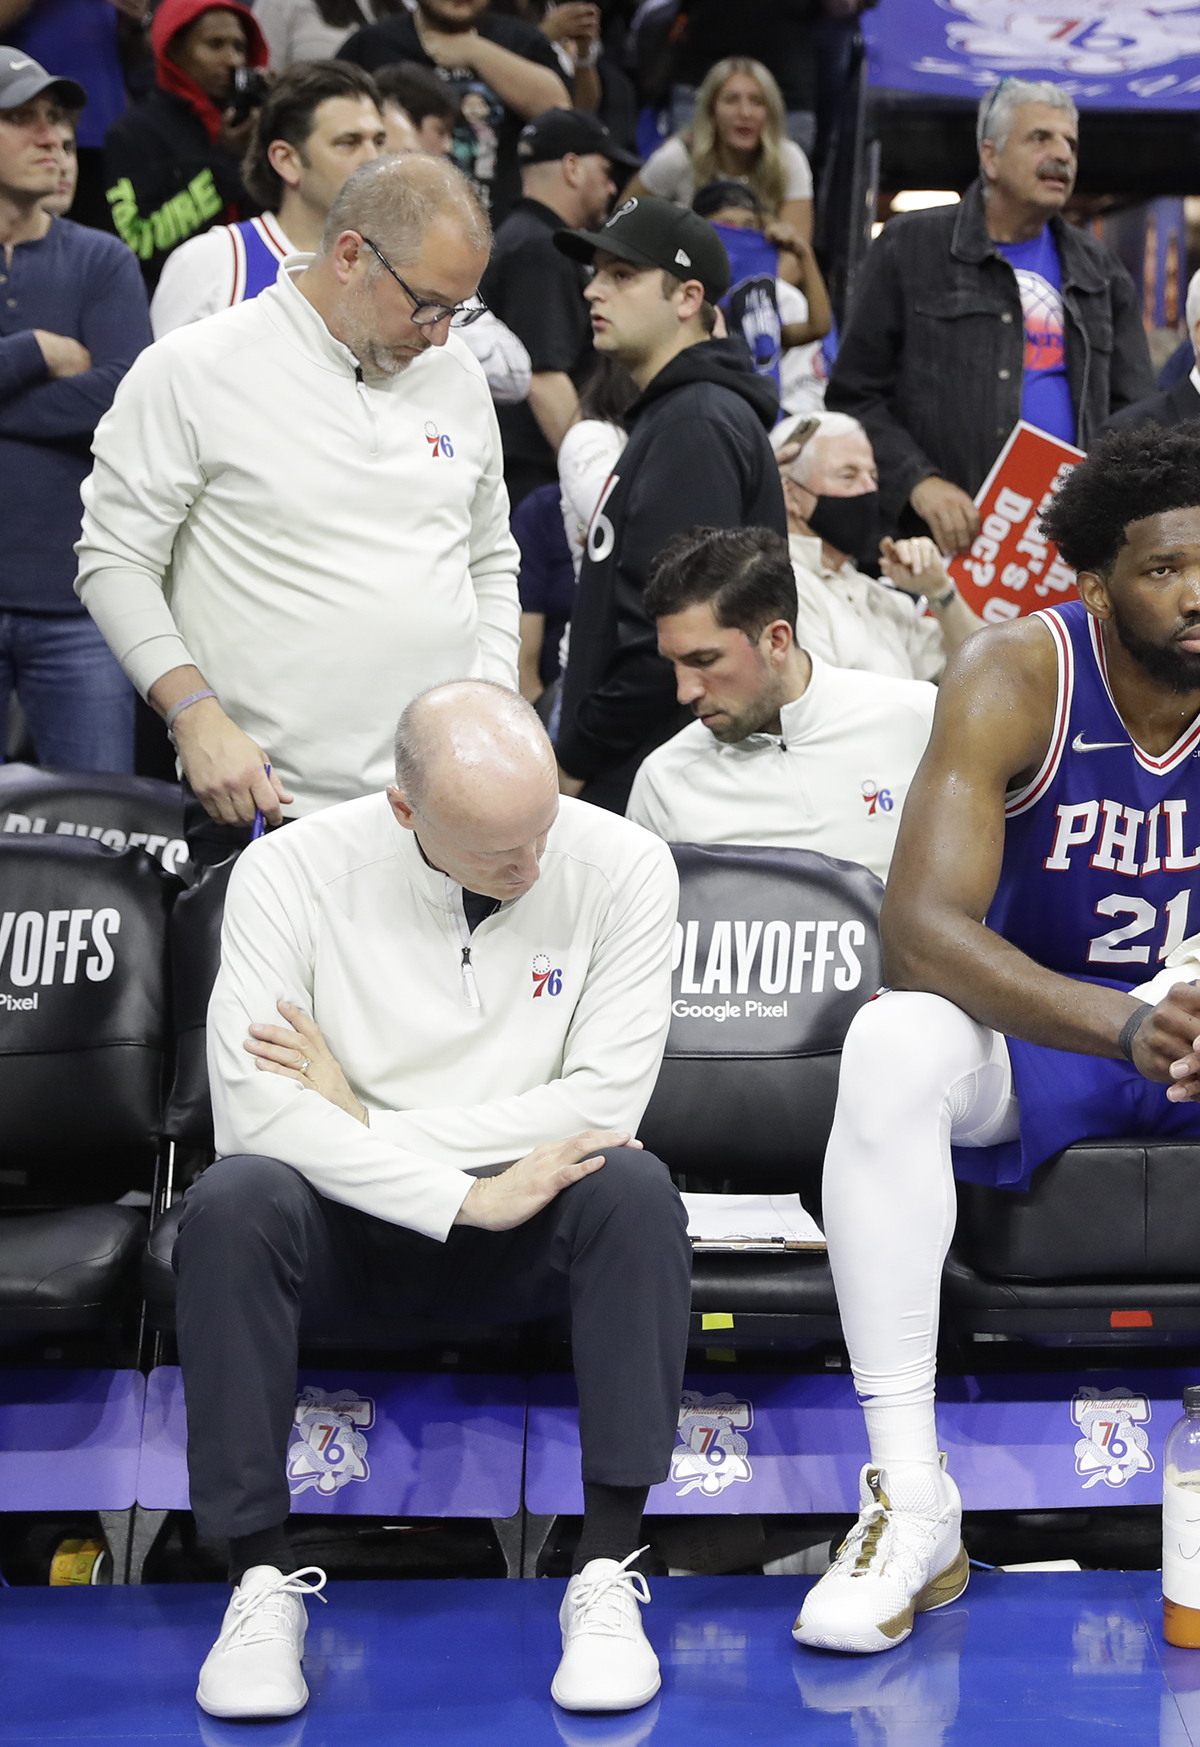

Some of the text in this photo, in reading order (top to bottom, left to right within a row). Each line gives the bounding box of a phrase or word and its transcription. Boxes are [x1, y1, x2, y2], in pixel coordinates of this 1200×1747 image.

[425, 434, 455, 458] 76
[962, 486, 1034, 588] Doc?
[861, 789, 894, 816] 76
[1086, 889, 1192, 965] 21
[532, 968, 563, 999] 76
[0, 992, 39, 1011] Pixel
[672, 1000, 788, 1022] Google Pixel
[1082, 1399, 1140, 1413] Philadelphia
[318, 1425, 345, 1465] 76
[699, 1428, 726, 1466] 76
[1099, 1422, 1128, 1458] 76
